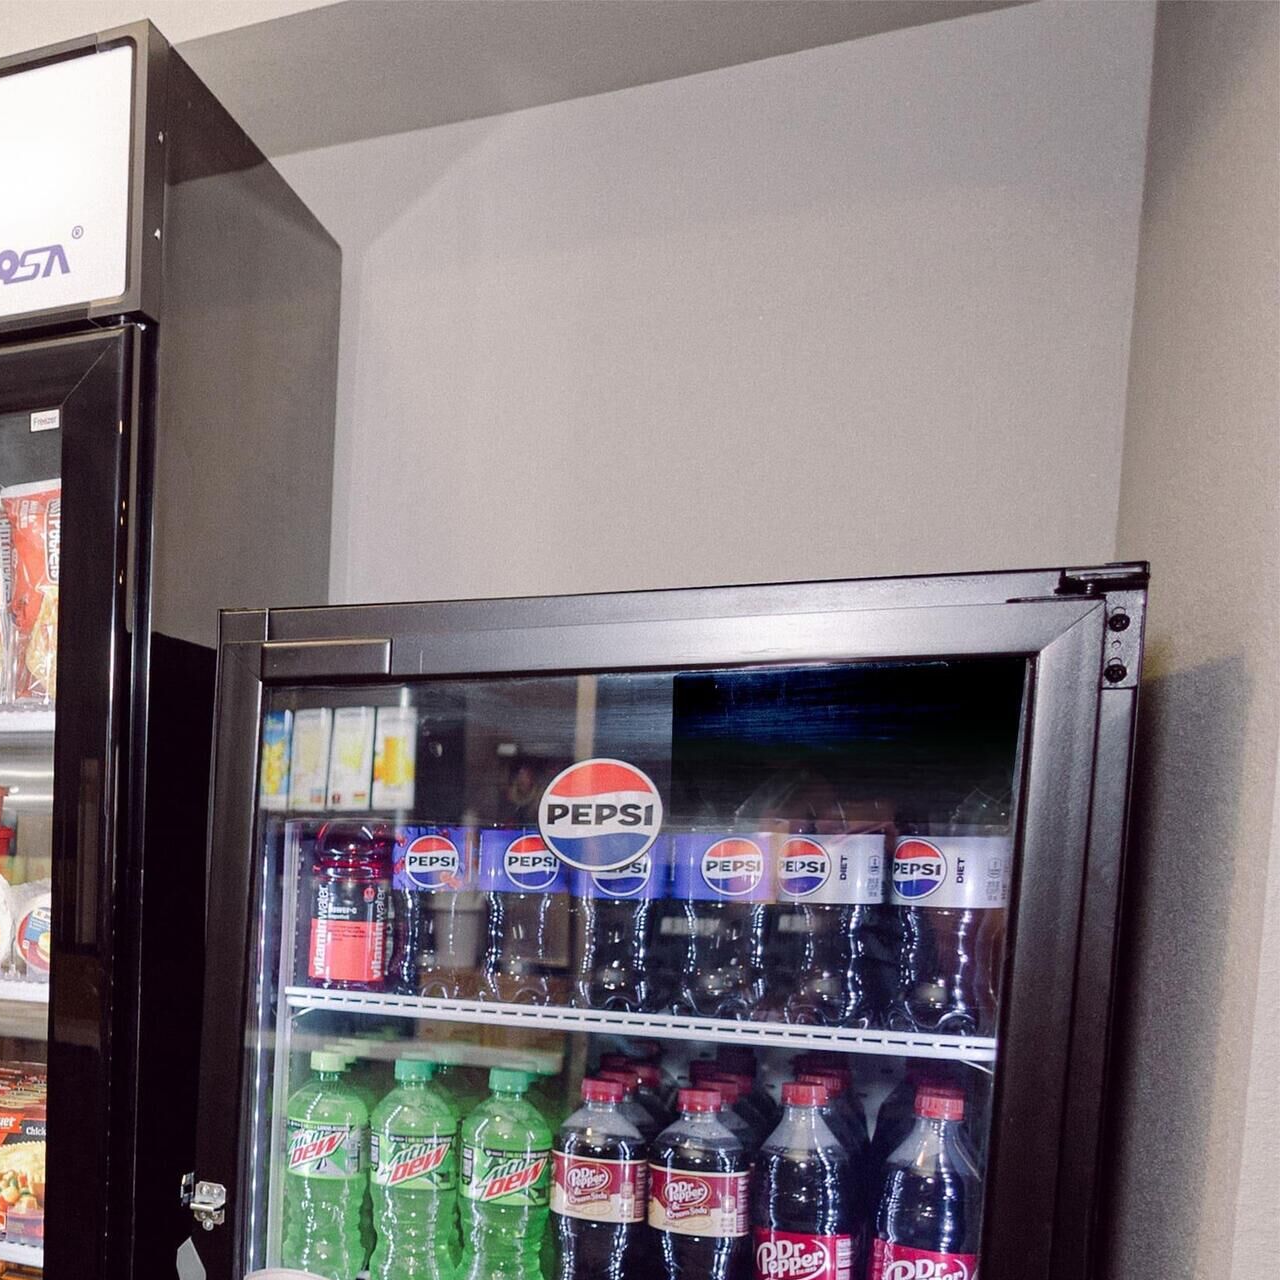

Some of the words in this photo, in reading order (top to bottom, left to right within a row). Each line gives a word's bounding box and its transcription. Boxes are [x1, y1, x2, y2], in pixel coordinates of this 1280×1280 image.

[33, 415, 57, 426] Freezer
[546, 803, 653, 826] PEPSI
[408, 856, 456, 868] PEPSI
[507, 856, 558, 868] PEPSI
[706, 860, 761, 873] PEPSI
[778, 860, 826, 873] PEPSI
[840, 855, 849, 881] DIET
[893, 862, 941, 876] PEPSI
[956, 856, 965, 884] DIET
[313, 884, 329, 976] vitaminwater
[372, 887, 386, 979] vitaminwater
[568, 1169, 607, 1189] Pepper
[665, 1182, 706, 1203] Pepper
[777, 1240, 805, 1257] Dr
[759, 1241, 825, 1278] Pepper
[915, 1259, 946, 1278] Dr
